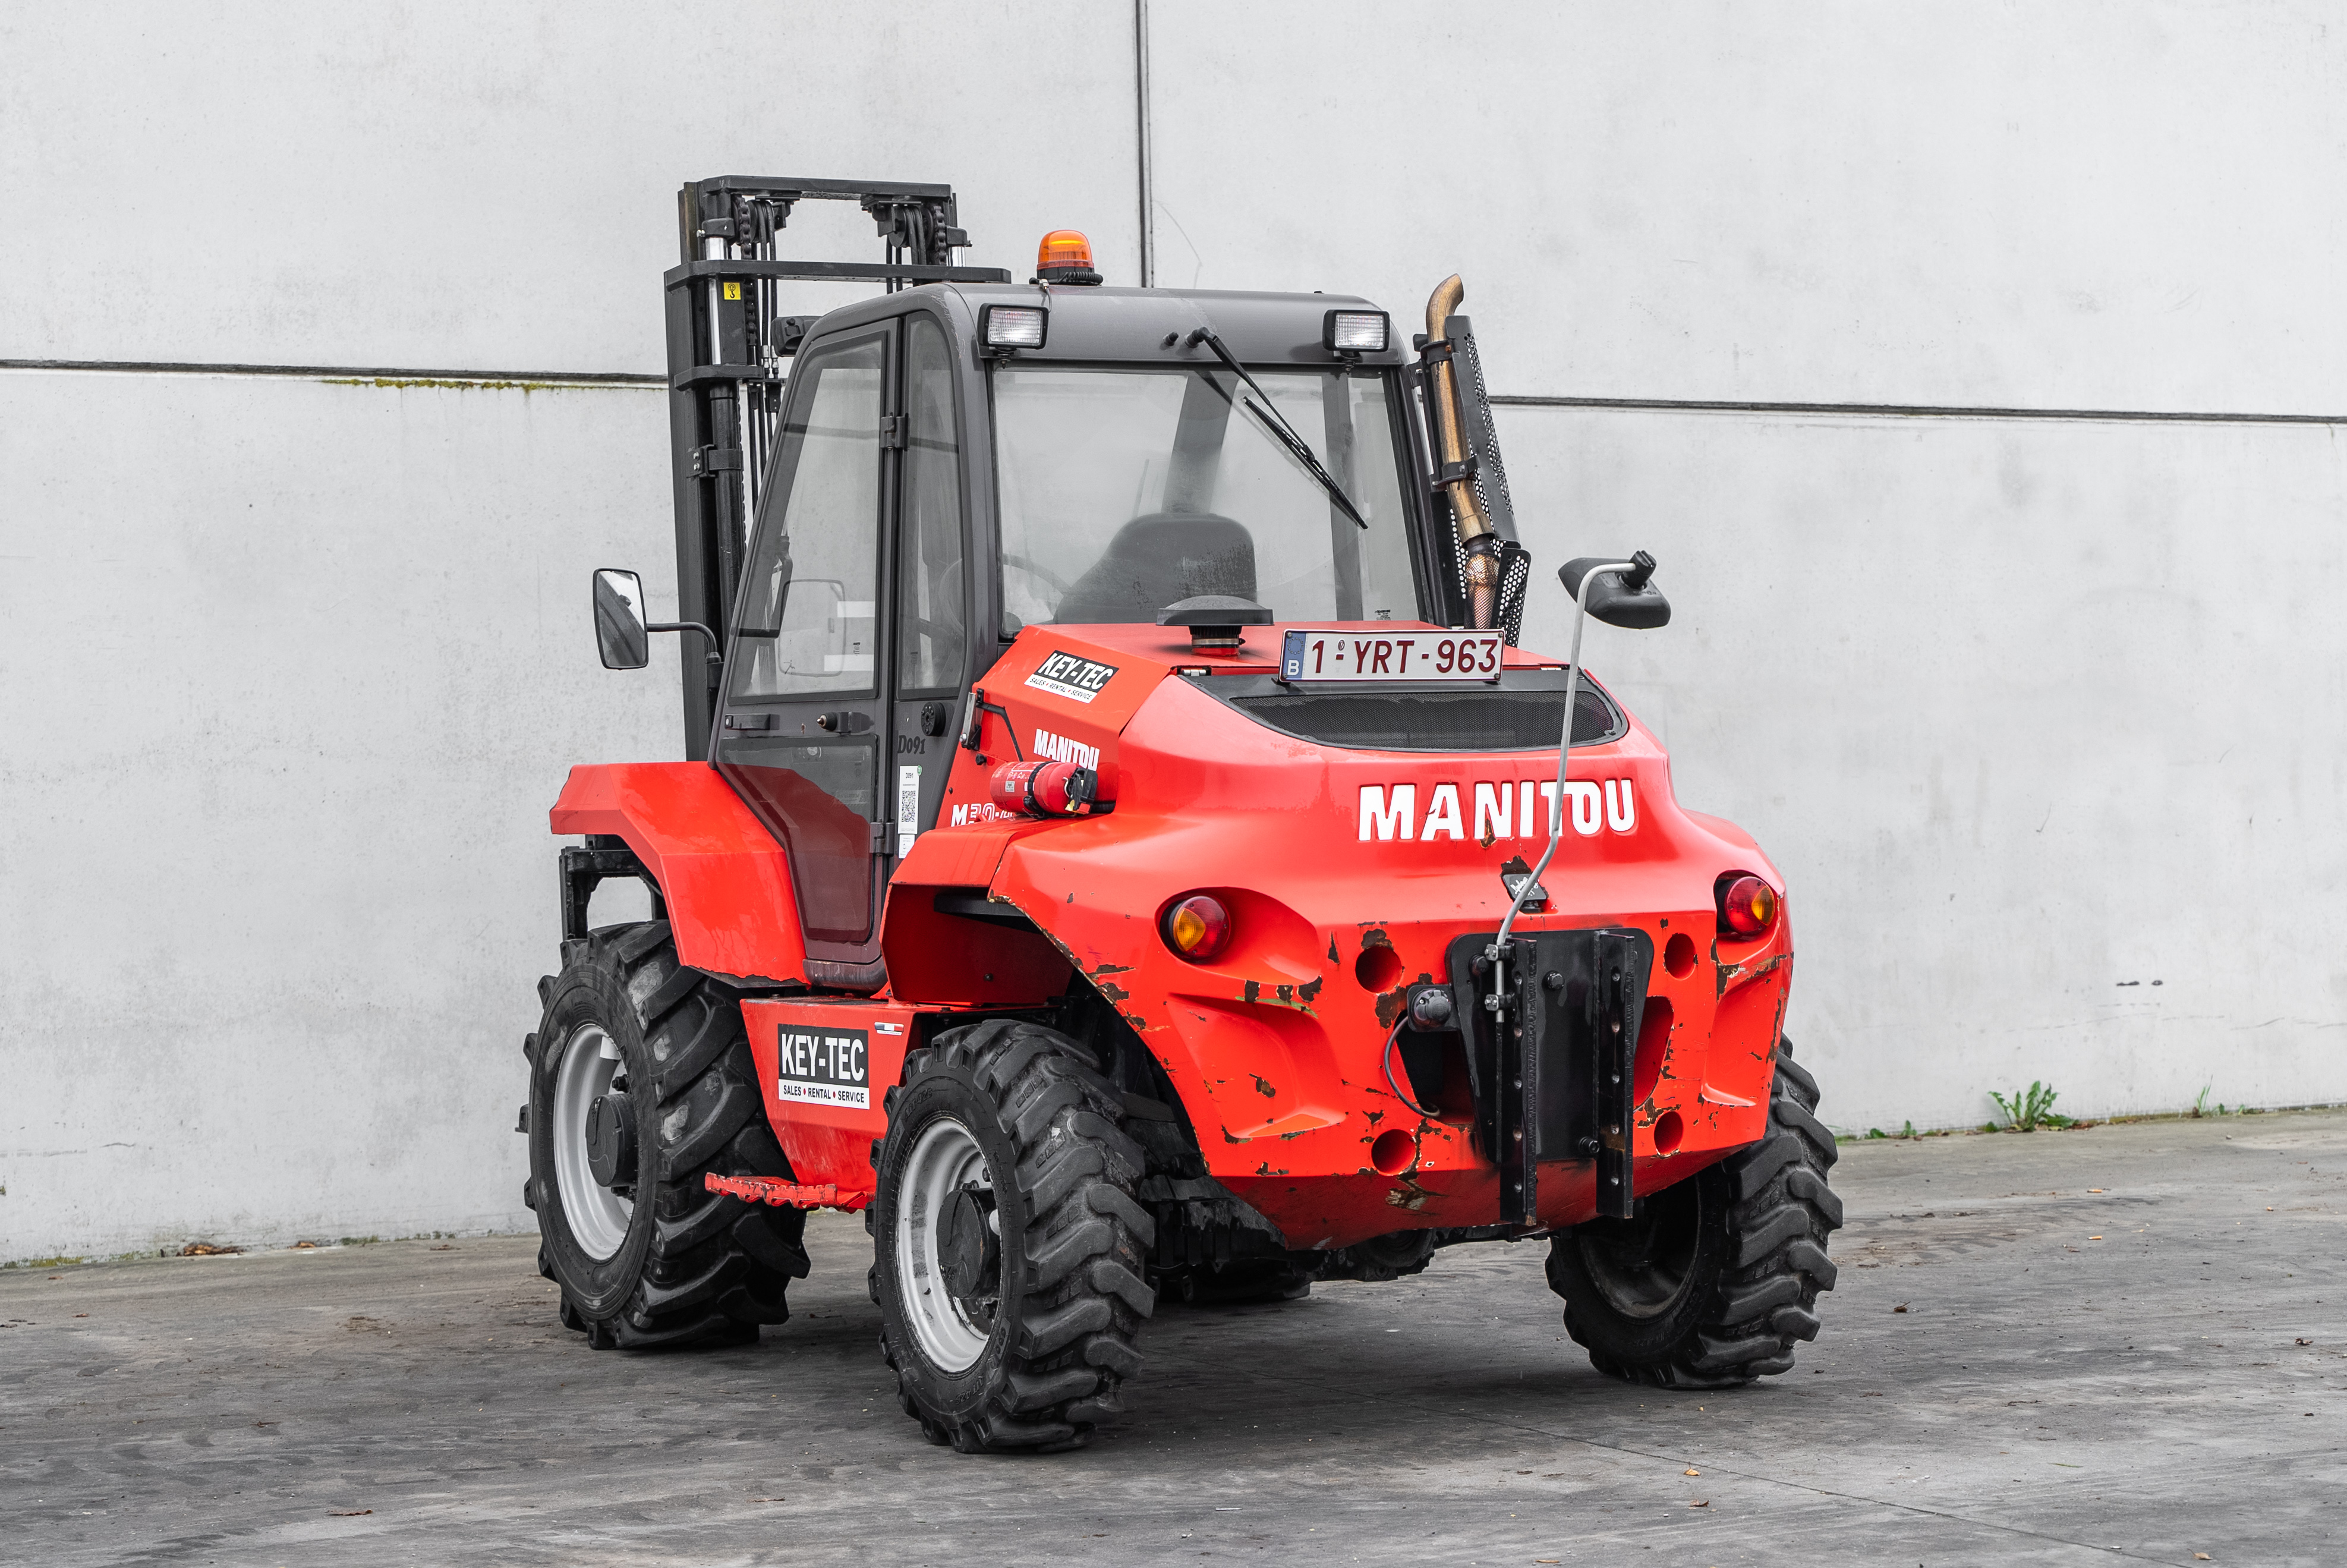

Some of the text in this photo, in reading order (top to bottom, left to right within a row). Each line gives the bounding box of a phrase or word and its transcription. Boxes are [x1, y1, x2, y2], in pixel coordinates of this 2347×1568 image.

[1038, 653, 1114, 690] KEY-TEC
[1287, 659, 1300, 676] B
[1029, 678, 1092, 700] SALES RENTAL SERVICE
[897, 735, 926, 755] D091
[1033, 728, 1100, 771] MANITOU
[1358, 778, 1636, 841] MANITOU
[782, 1033, 865, 1082] KEY-TEC
[783, 1085, 864, 1103] SALES RENTAL SERVICE
